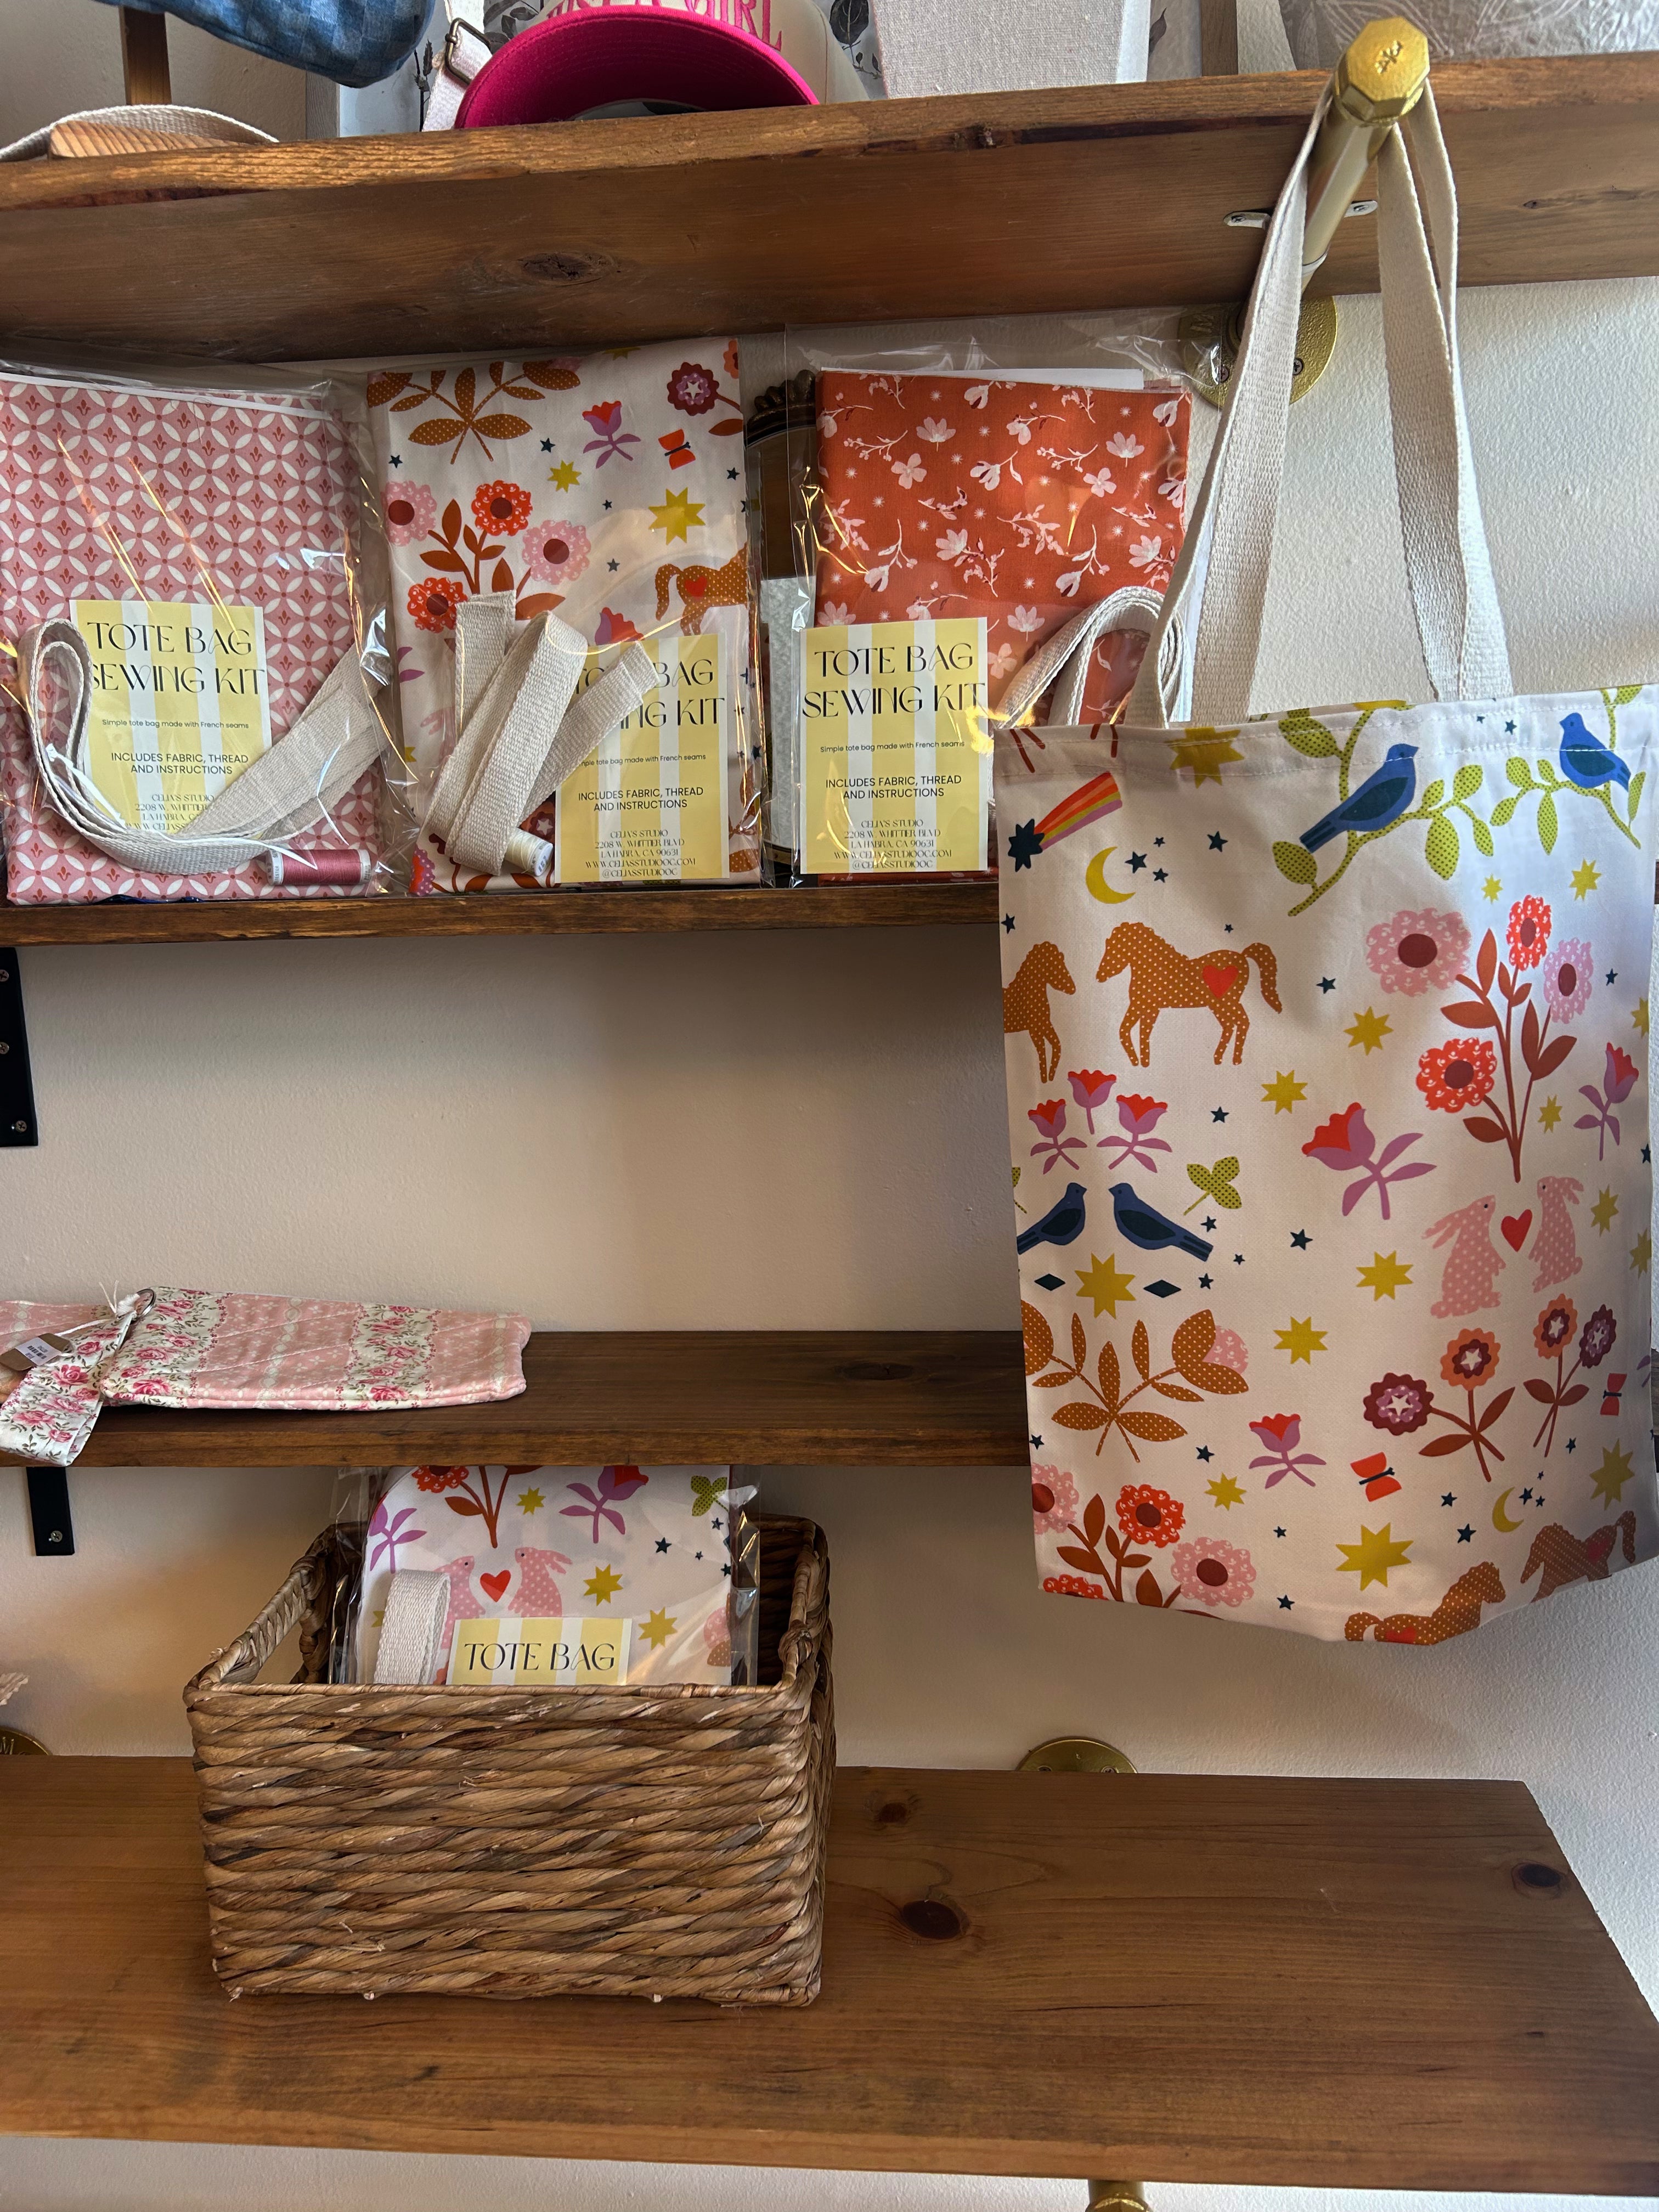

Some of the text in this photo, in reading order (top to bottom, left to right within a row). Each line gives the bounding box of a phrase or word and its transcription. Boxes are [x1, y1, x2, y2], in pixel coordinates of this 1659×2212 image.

[87, 622, 252, 656] TOTE BAG
[814, 642, 973, 677] TOTE BAG
[653, 659, 713, 688] BAG
[215, 668, 265, 695] KIT
[802, 682, 985, 718] SEWING KIT
[677, 698, 725, 726] KIT
[111, 753, 249, 764] INCLUDES FABRIC, THREAD
[131, 764, 233, 774] AND INSTRUCTIONS
[826, 775, 962, 788] INCLUDES FABRIC, THREAD
[184, 794, 215, 802] STUDIO
[578, 787, 703, 801] INCLUDES FABRIC, THREAD
[843, 788, 944, 799] AND INSTRUCTIONS
[594, 799, 687, 811] AND INSTRUCTIONS
[893, 819, 923, 827] STUDIO
[879, 830, 916, 838] WHITTIER
[464, 1643, 615, 1671] TOTE BAG
